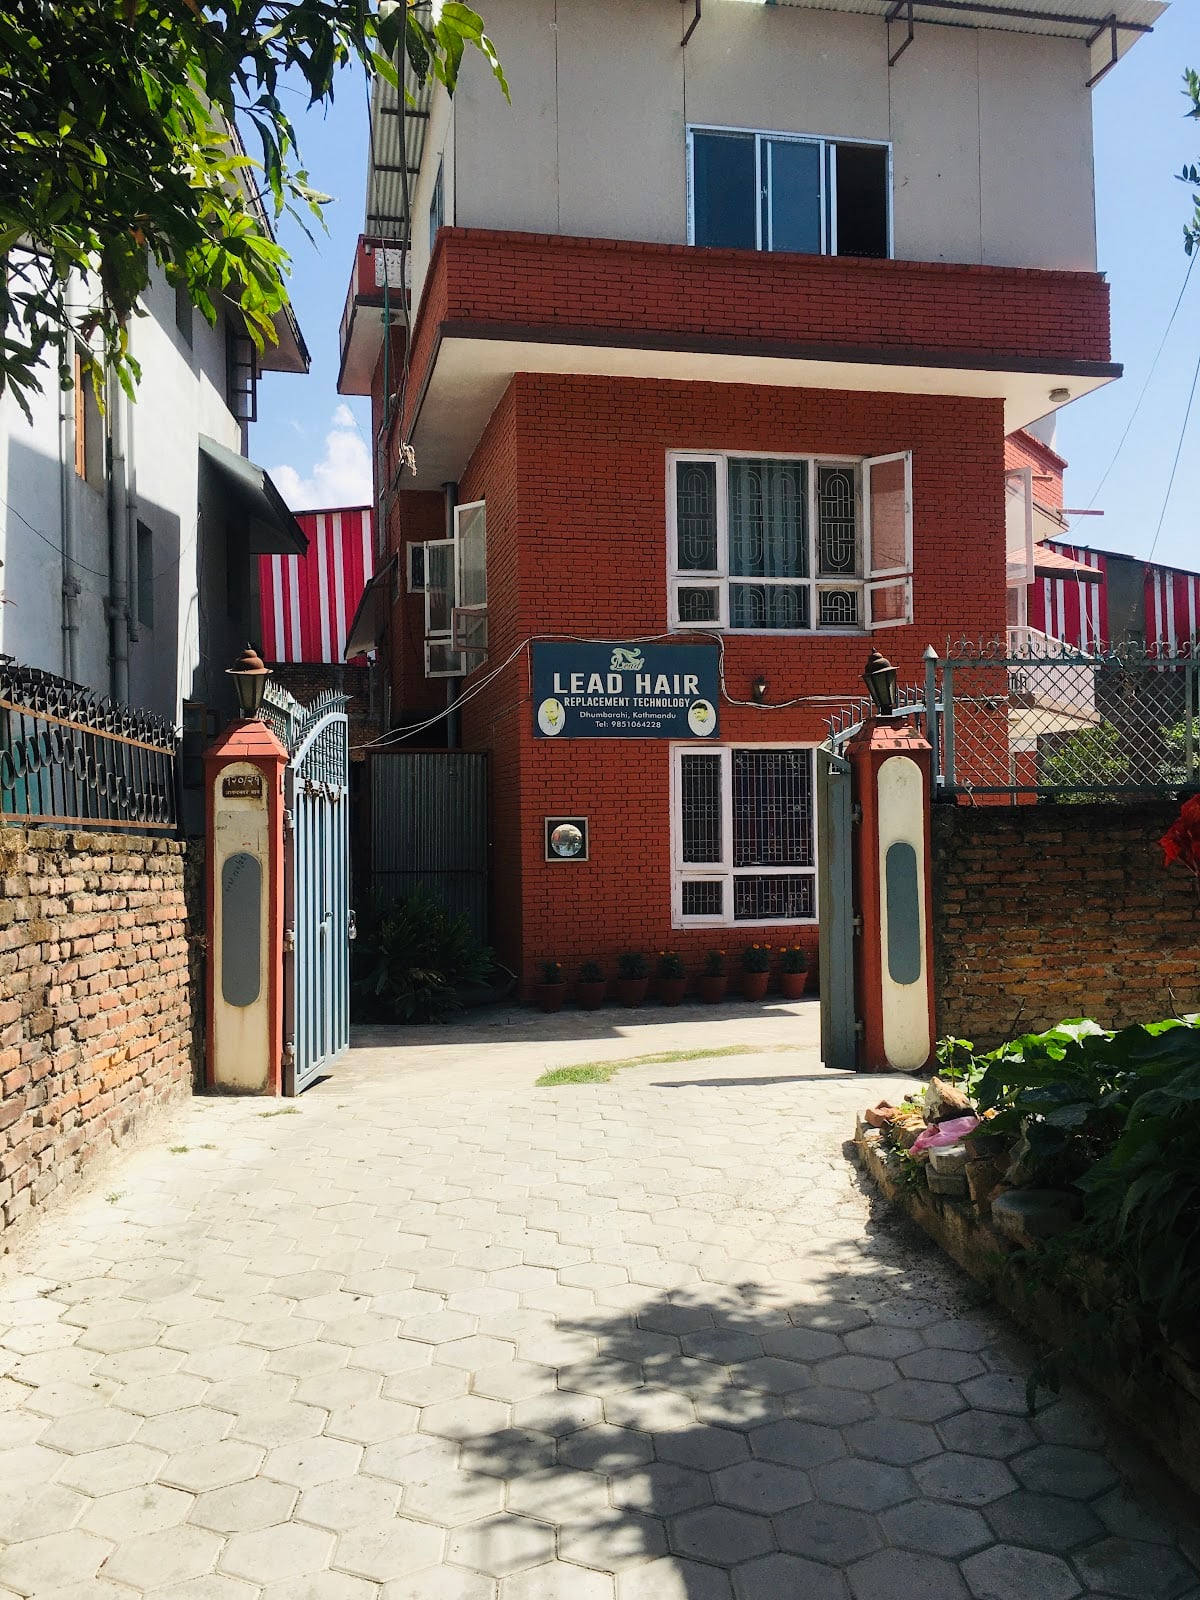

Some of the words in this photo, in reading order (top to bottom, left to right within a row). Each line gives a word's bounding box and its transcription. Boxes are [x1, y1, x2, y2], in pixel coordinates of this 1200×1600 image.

[553, 673, 623, 694] LEAD
[636, 674, 700, 695] HAIR
[564, 697, 630, 707] REPLACEMENT
[633, 698, 690, 707] TECHNOLOGY
